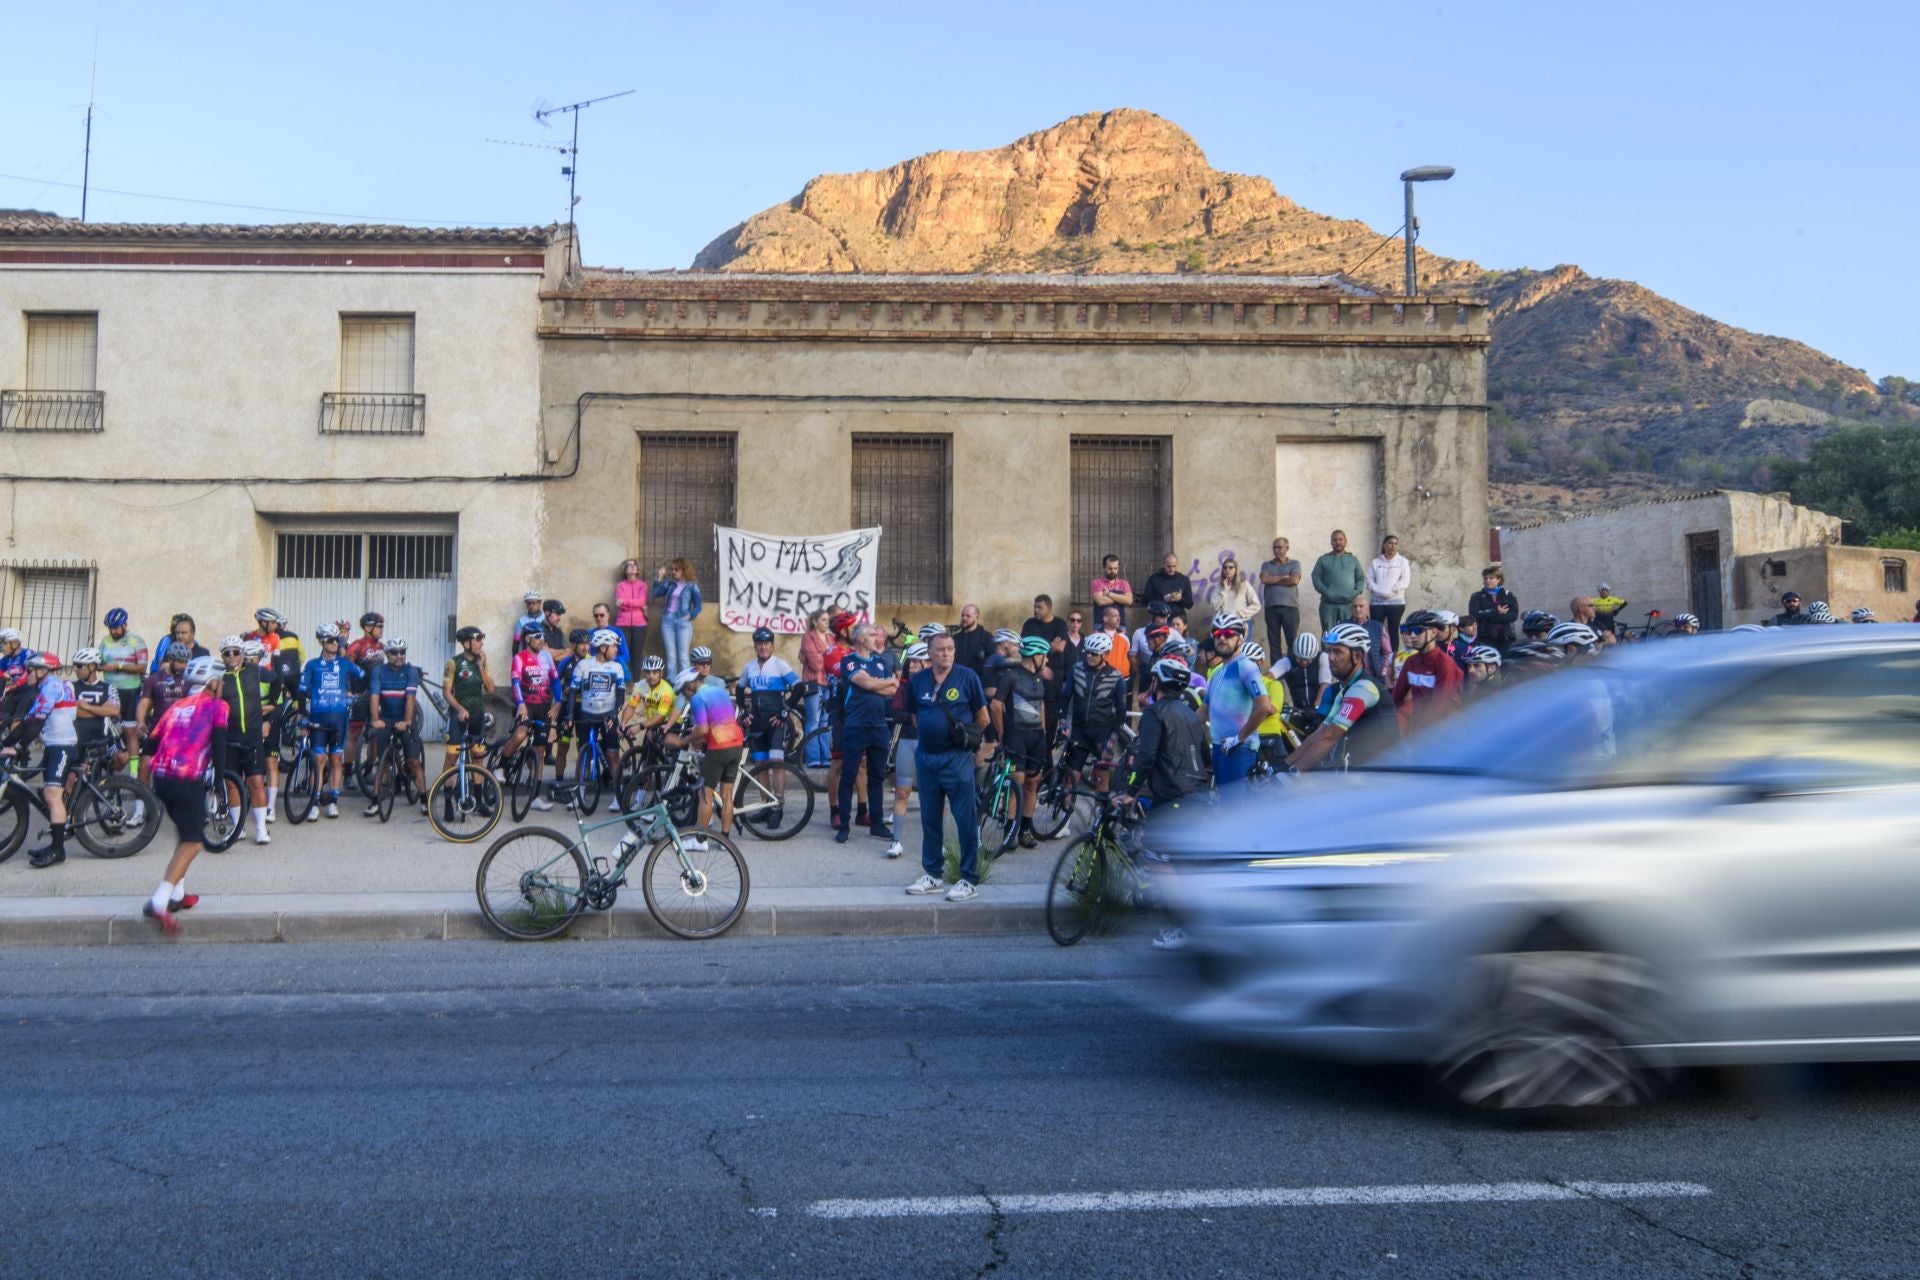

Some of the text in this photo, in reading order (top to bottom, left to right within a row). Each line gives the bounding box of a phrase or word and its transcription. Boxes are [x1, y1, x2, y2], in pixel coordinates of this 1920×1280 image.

[728, 537, 827, 574] NO MÁS
[726, 577, 870, 616] MUERTOS
